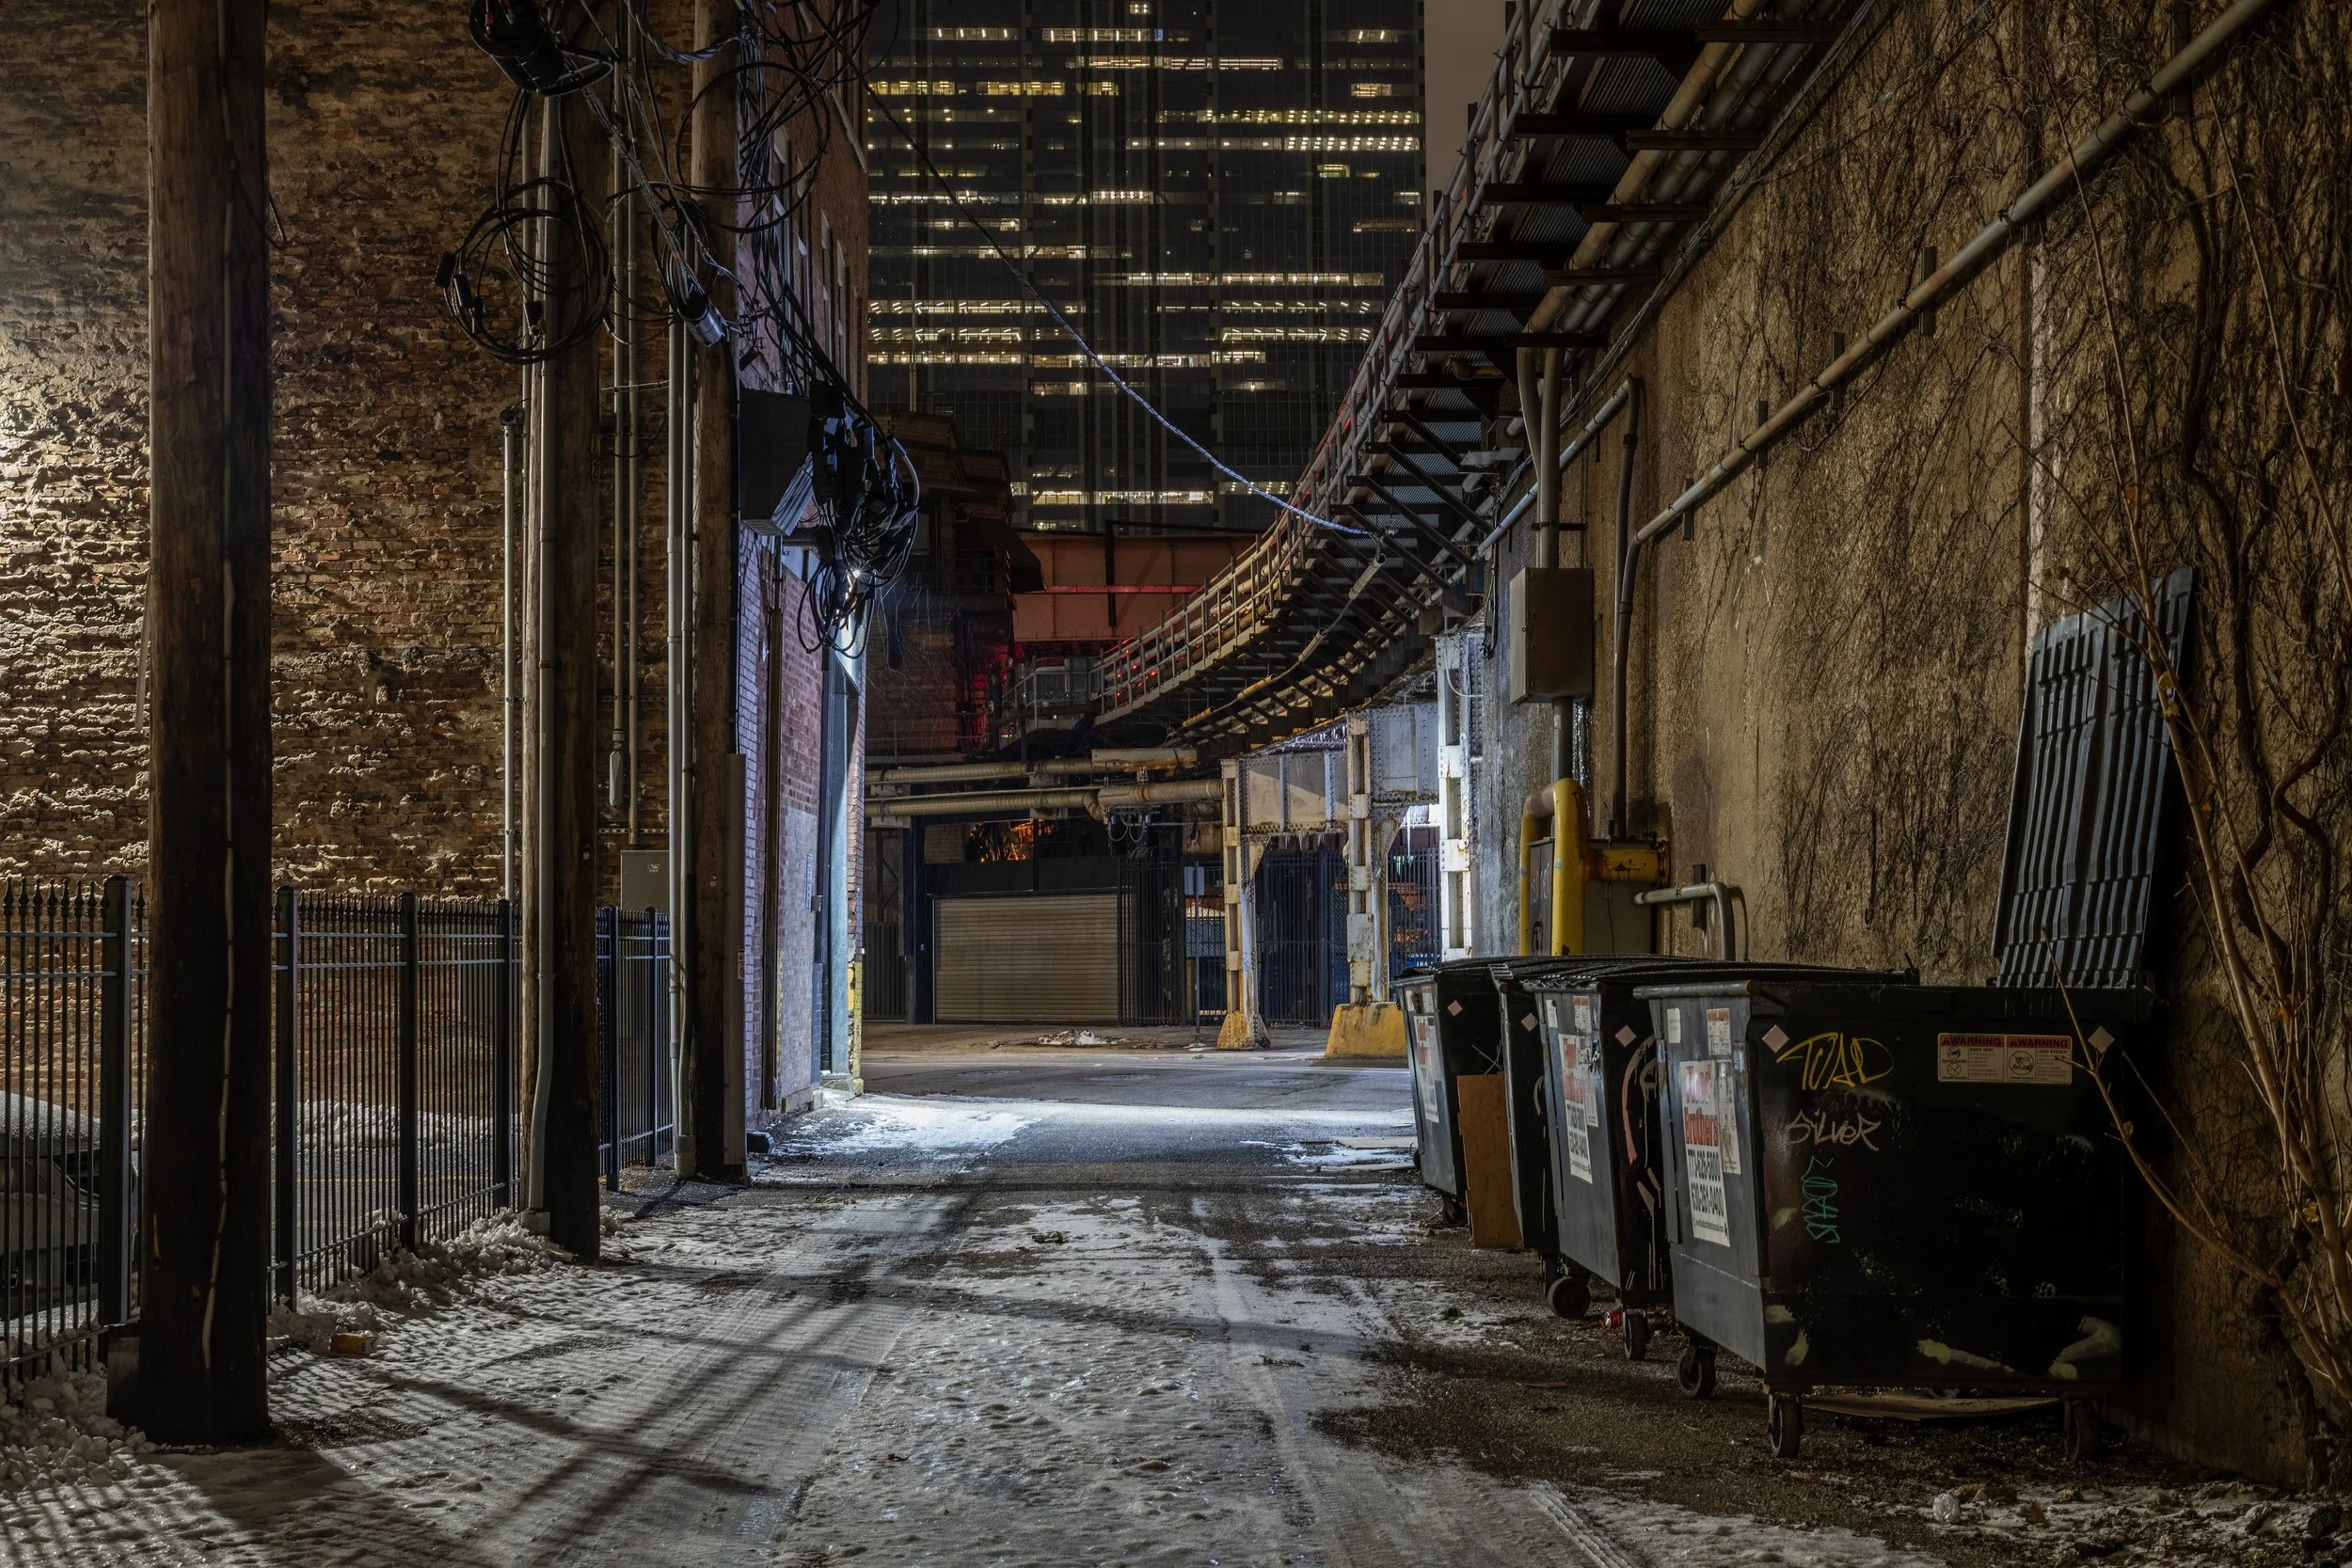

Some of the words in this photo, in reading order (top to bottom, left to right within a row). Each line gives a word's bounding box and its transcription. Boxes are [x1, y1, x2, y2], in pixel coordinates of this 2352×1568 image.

[1950, 1036, 2001, 1046] WARNING
[2018, 1037, 2068, 1048] WARNING
[1684, 1107, 1719, 1147] Brothers
